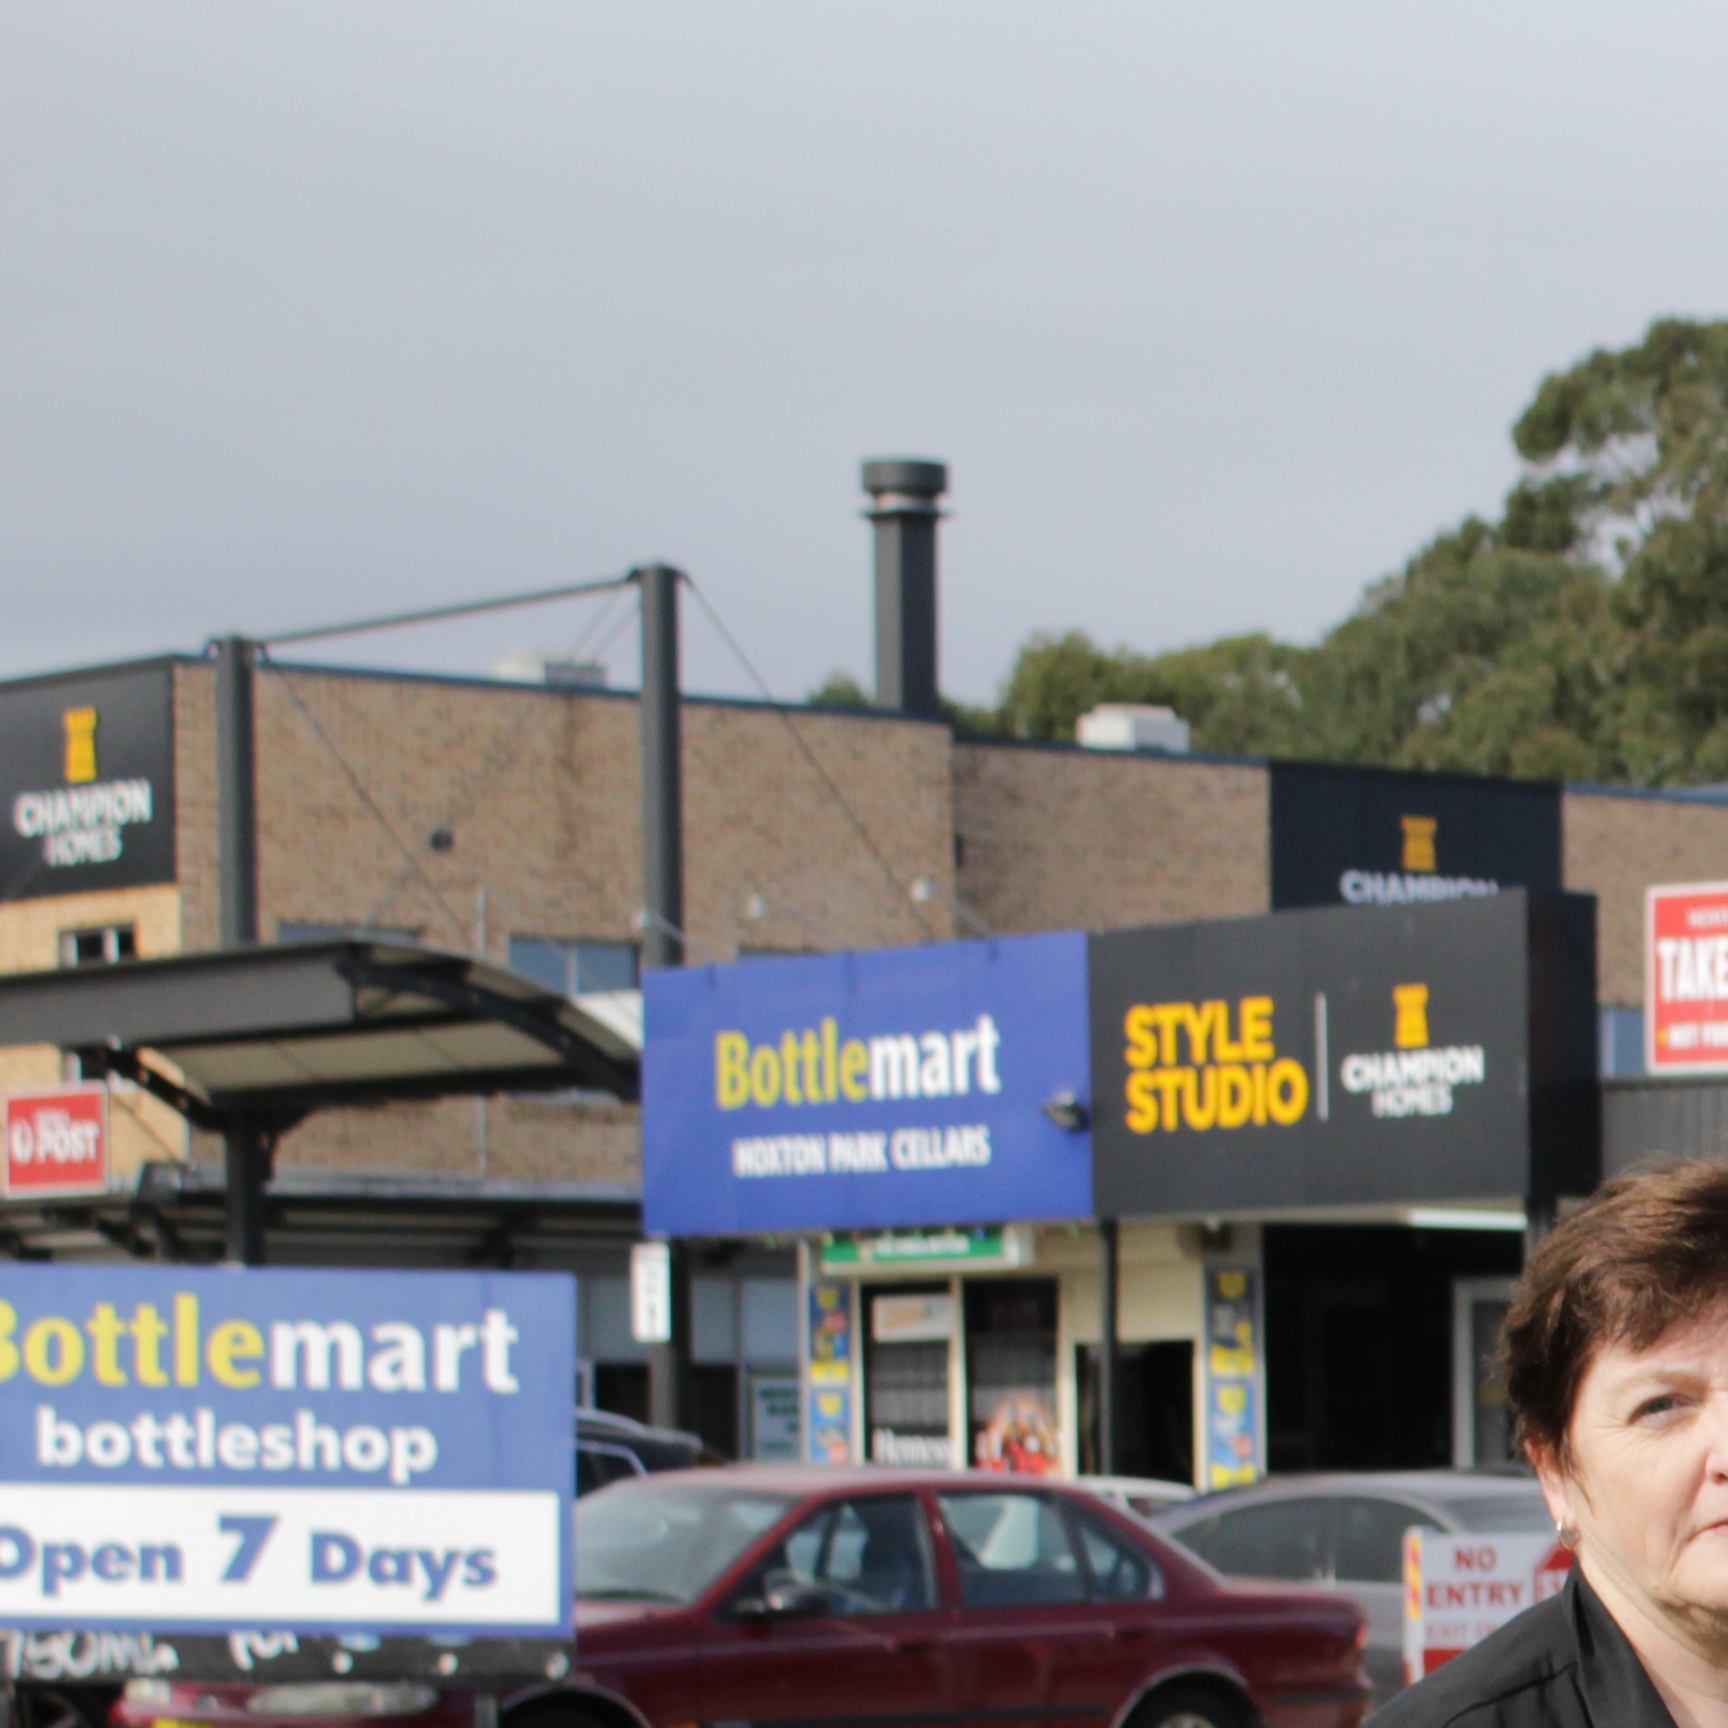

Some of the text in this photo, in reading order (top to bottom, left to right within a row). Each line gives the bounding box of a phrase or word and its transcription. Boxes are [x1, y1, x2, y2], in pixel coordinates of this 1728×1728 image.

[14, 779, 153, 838] CHAMPION
[45, 826, 122, 867] HOMES
[1124, 996, 1274, 1068] STYLE
[716, 1013, 1001, 1110] Bottlemart
[1341, 1045, 1484, 1092] CHAMPION
[1125, 1057, 1309, 1133] STUDIO
[1371, 1085, 1453, 1118] HOMES
[37, 1121, 101, 1163] POST
[733, 1125, 991, 1177] HOXTON PARK CELLARS
[37, 1405, 438, 1486] bottleshop
[217, 1515, 281, 1582] 7
[310, 1531, 499, 1602] Days
[1456, 1546, 1496, 1572] NO
[1428, 1582, 1523, 1608] ENTRY
